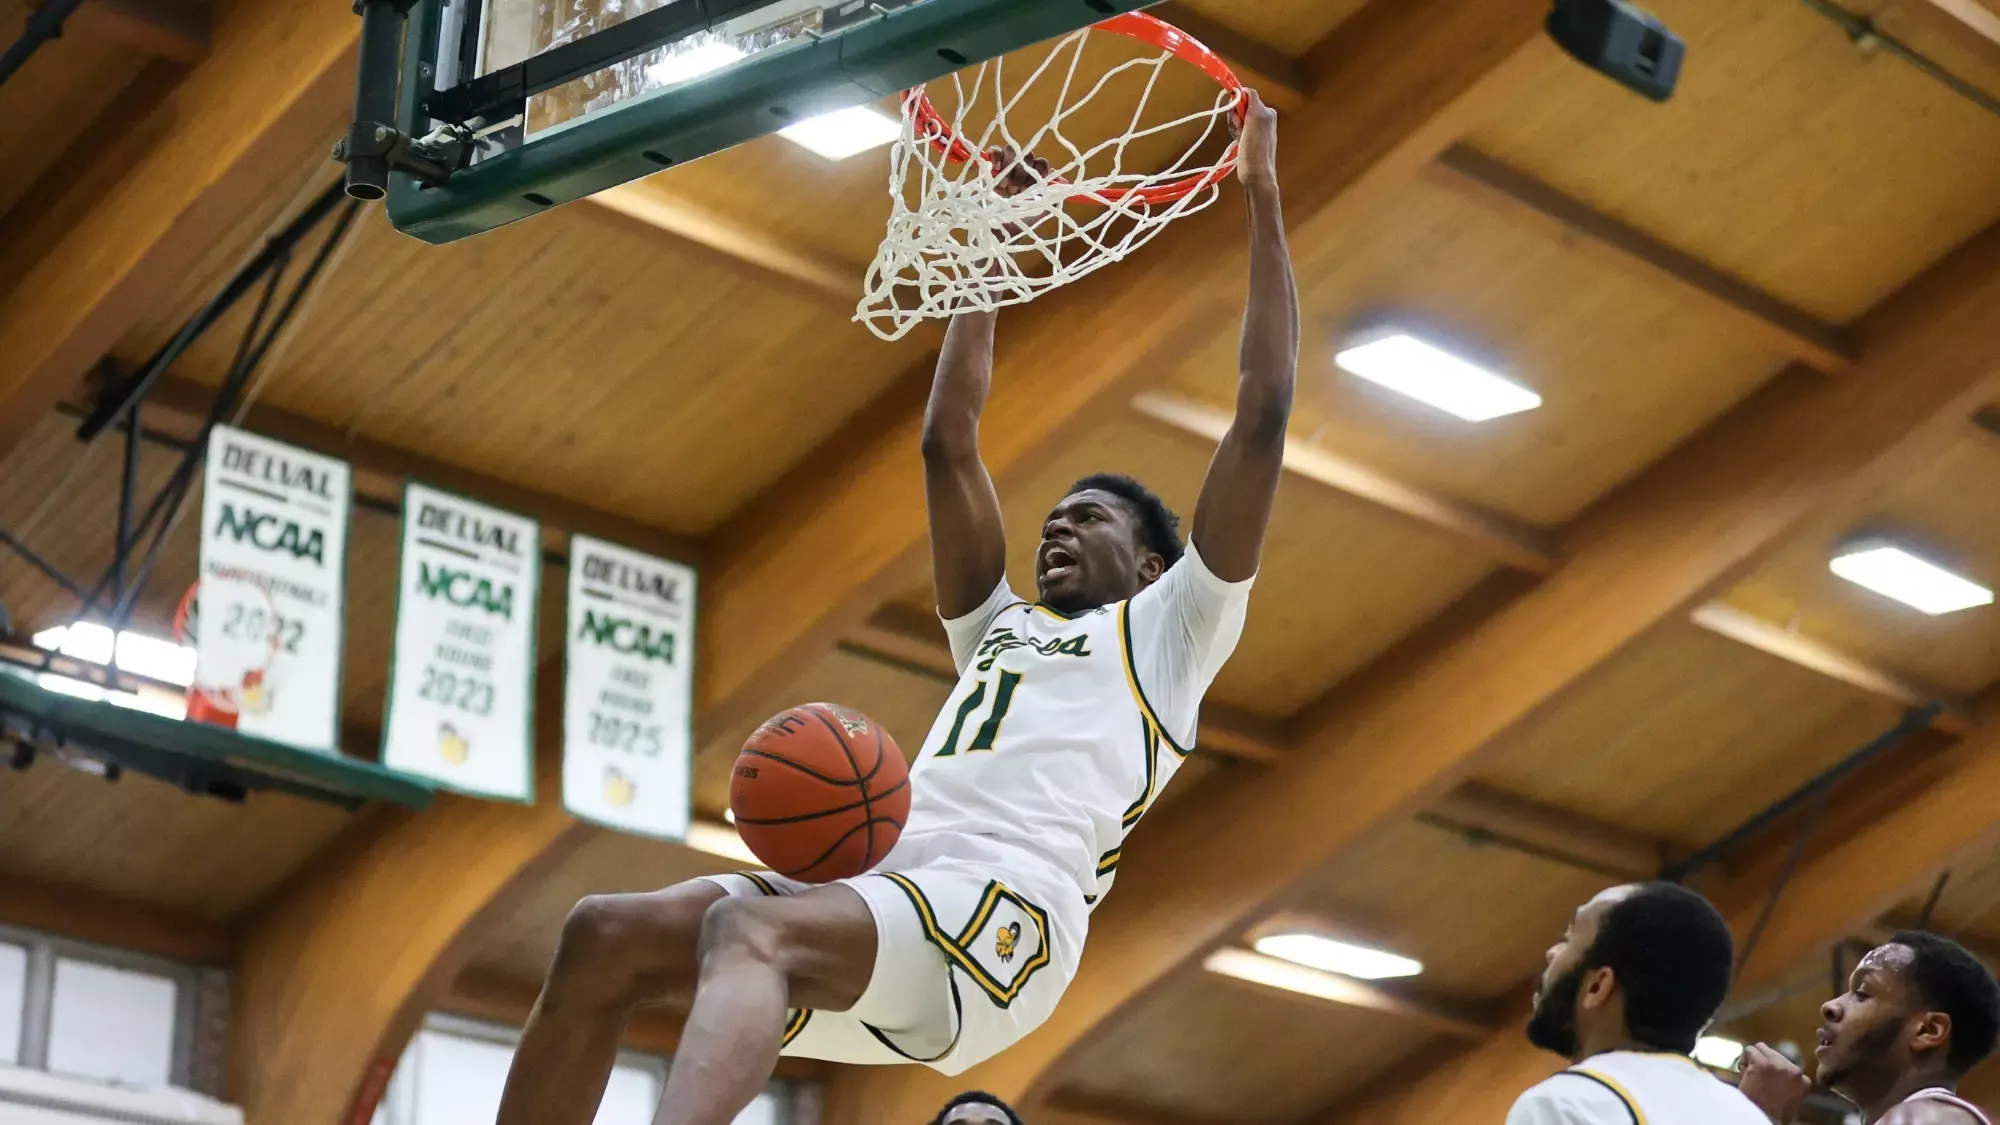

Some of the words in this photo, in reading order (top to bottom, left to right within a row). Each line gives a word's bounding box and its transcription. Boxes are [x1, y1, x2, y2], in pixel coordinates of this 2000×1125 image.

[221, 443, 333, 499] DELVAL
[215, 503, 324, 566] NCAA
[417, 504, 523, 557] DELVAL
[414, 560, 513, 621] NCAA
[583, 554, 681, 605] DELVAL
[221, 602, 306, 655] 2022
[578, 607, 674, 665] NCAA
[417, 664, 496, 717] 2023
[932, 667, 1025, 757] 11
[587, 708, 665, 758] 2025
